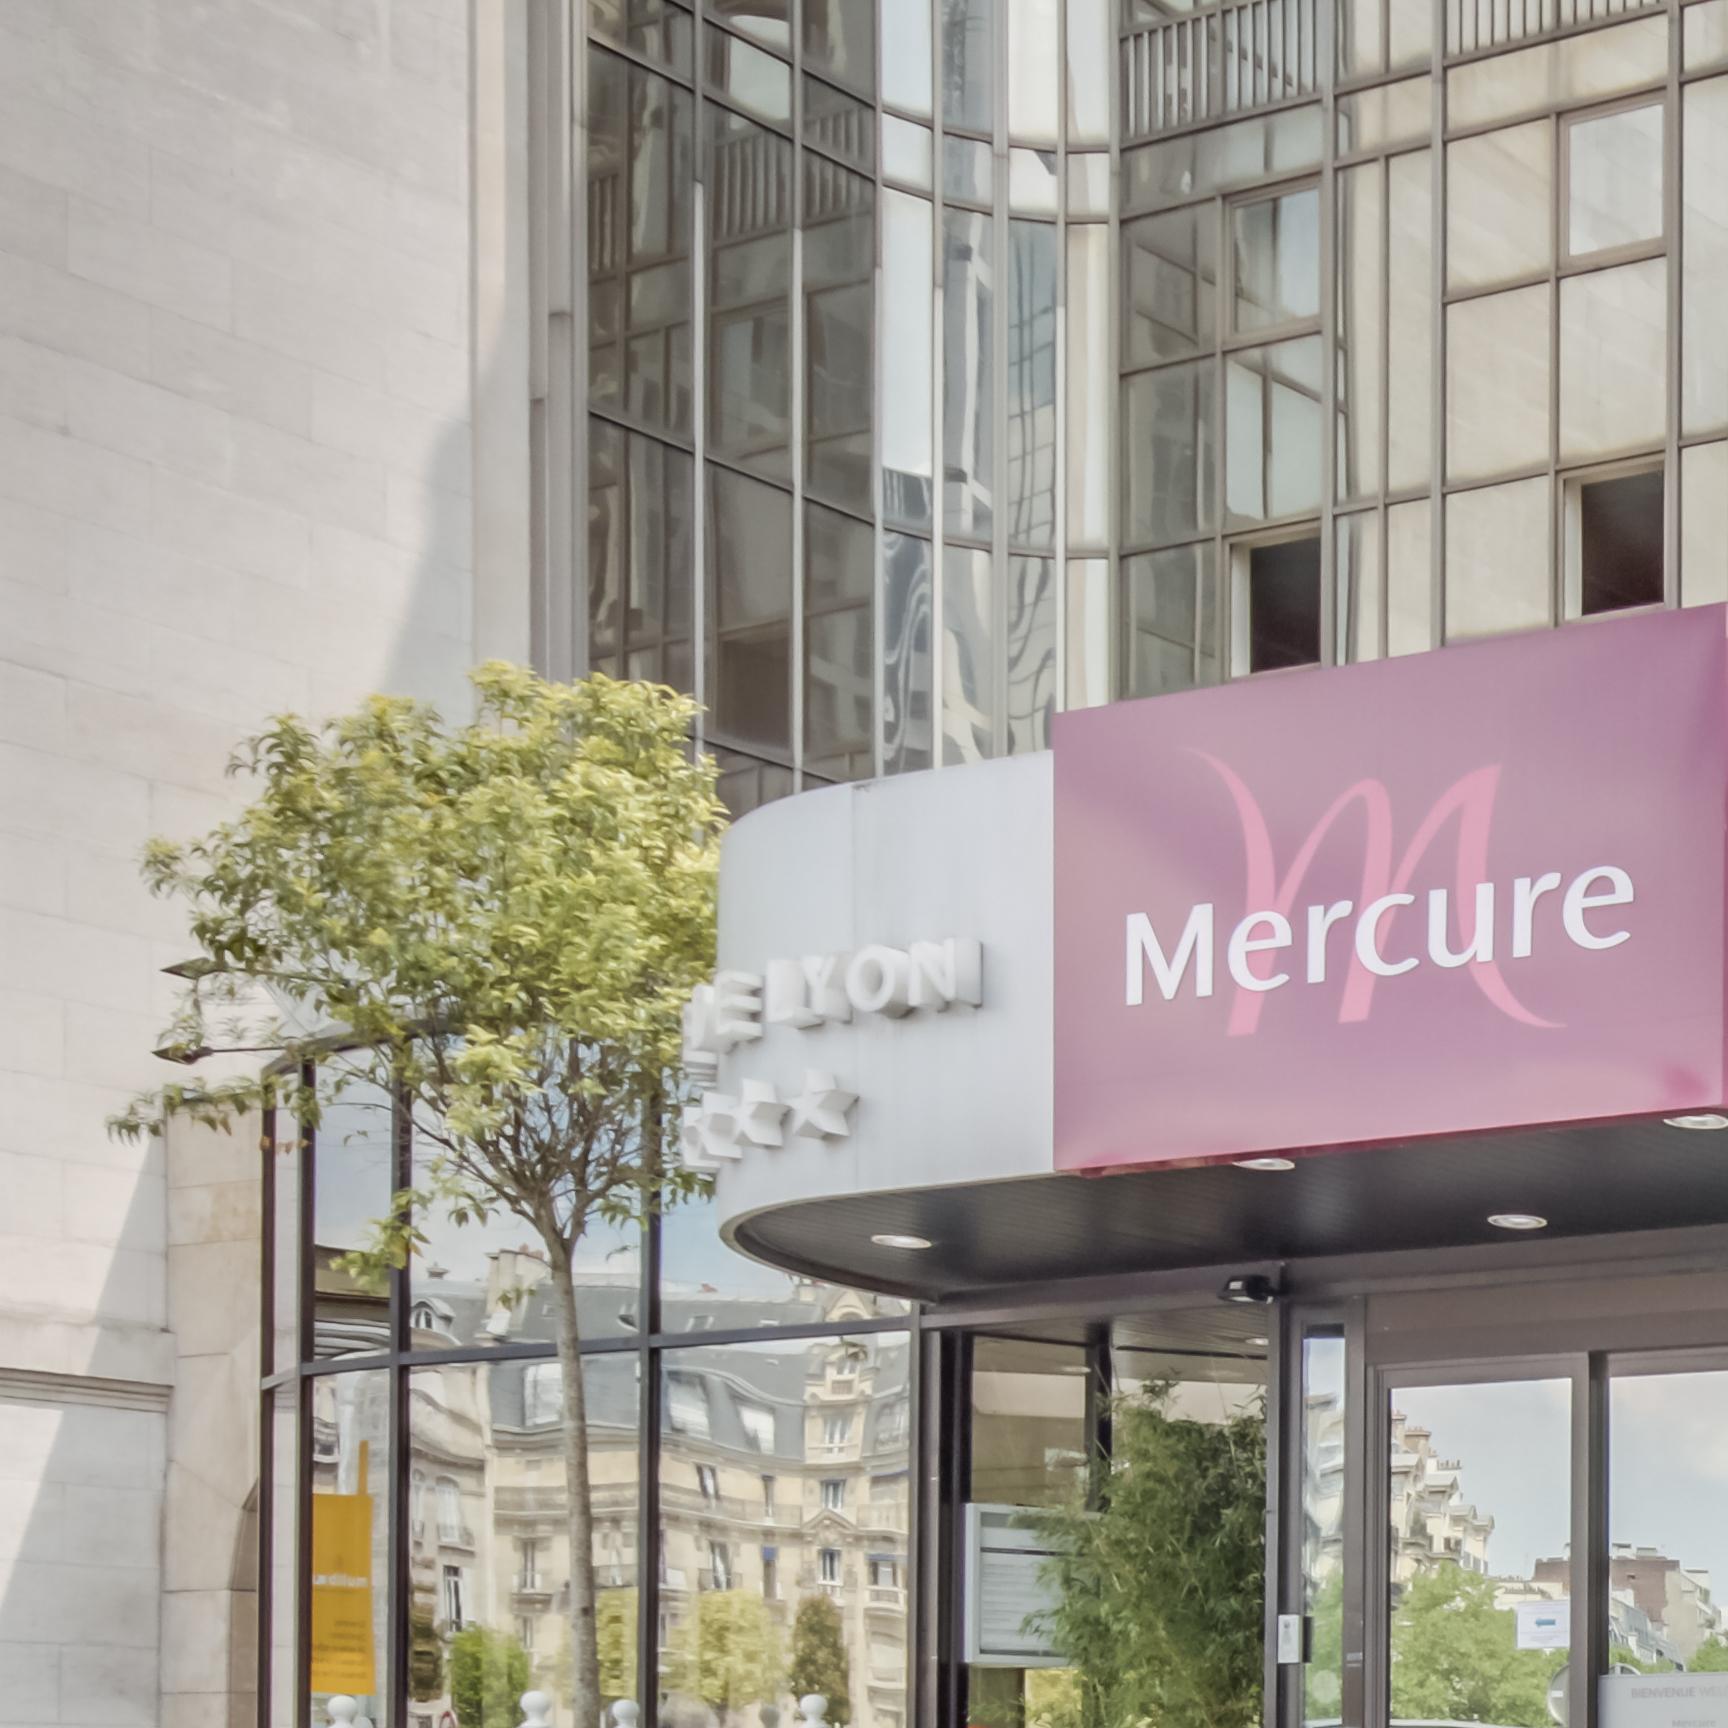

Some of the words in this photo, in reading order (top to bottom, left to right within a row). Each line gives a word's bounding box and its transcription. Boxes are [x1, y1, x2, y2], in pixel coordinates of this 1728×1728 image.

[1124, 863, 1635, 1007] Mercure
[764, 937, 982, 1031] LYON
[1631, 1686, 1696, 1699] BIENVENUE
